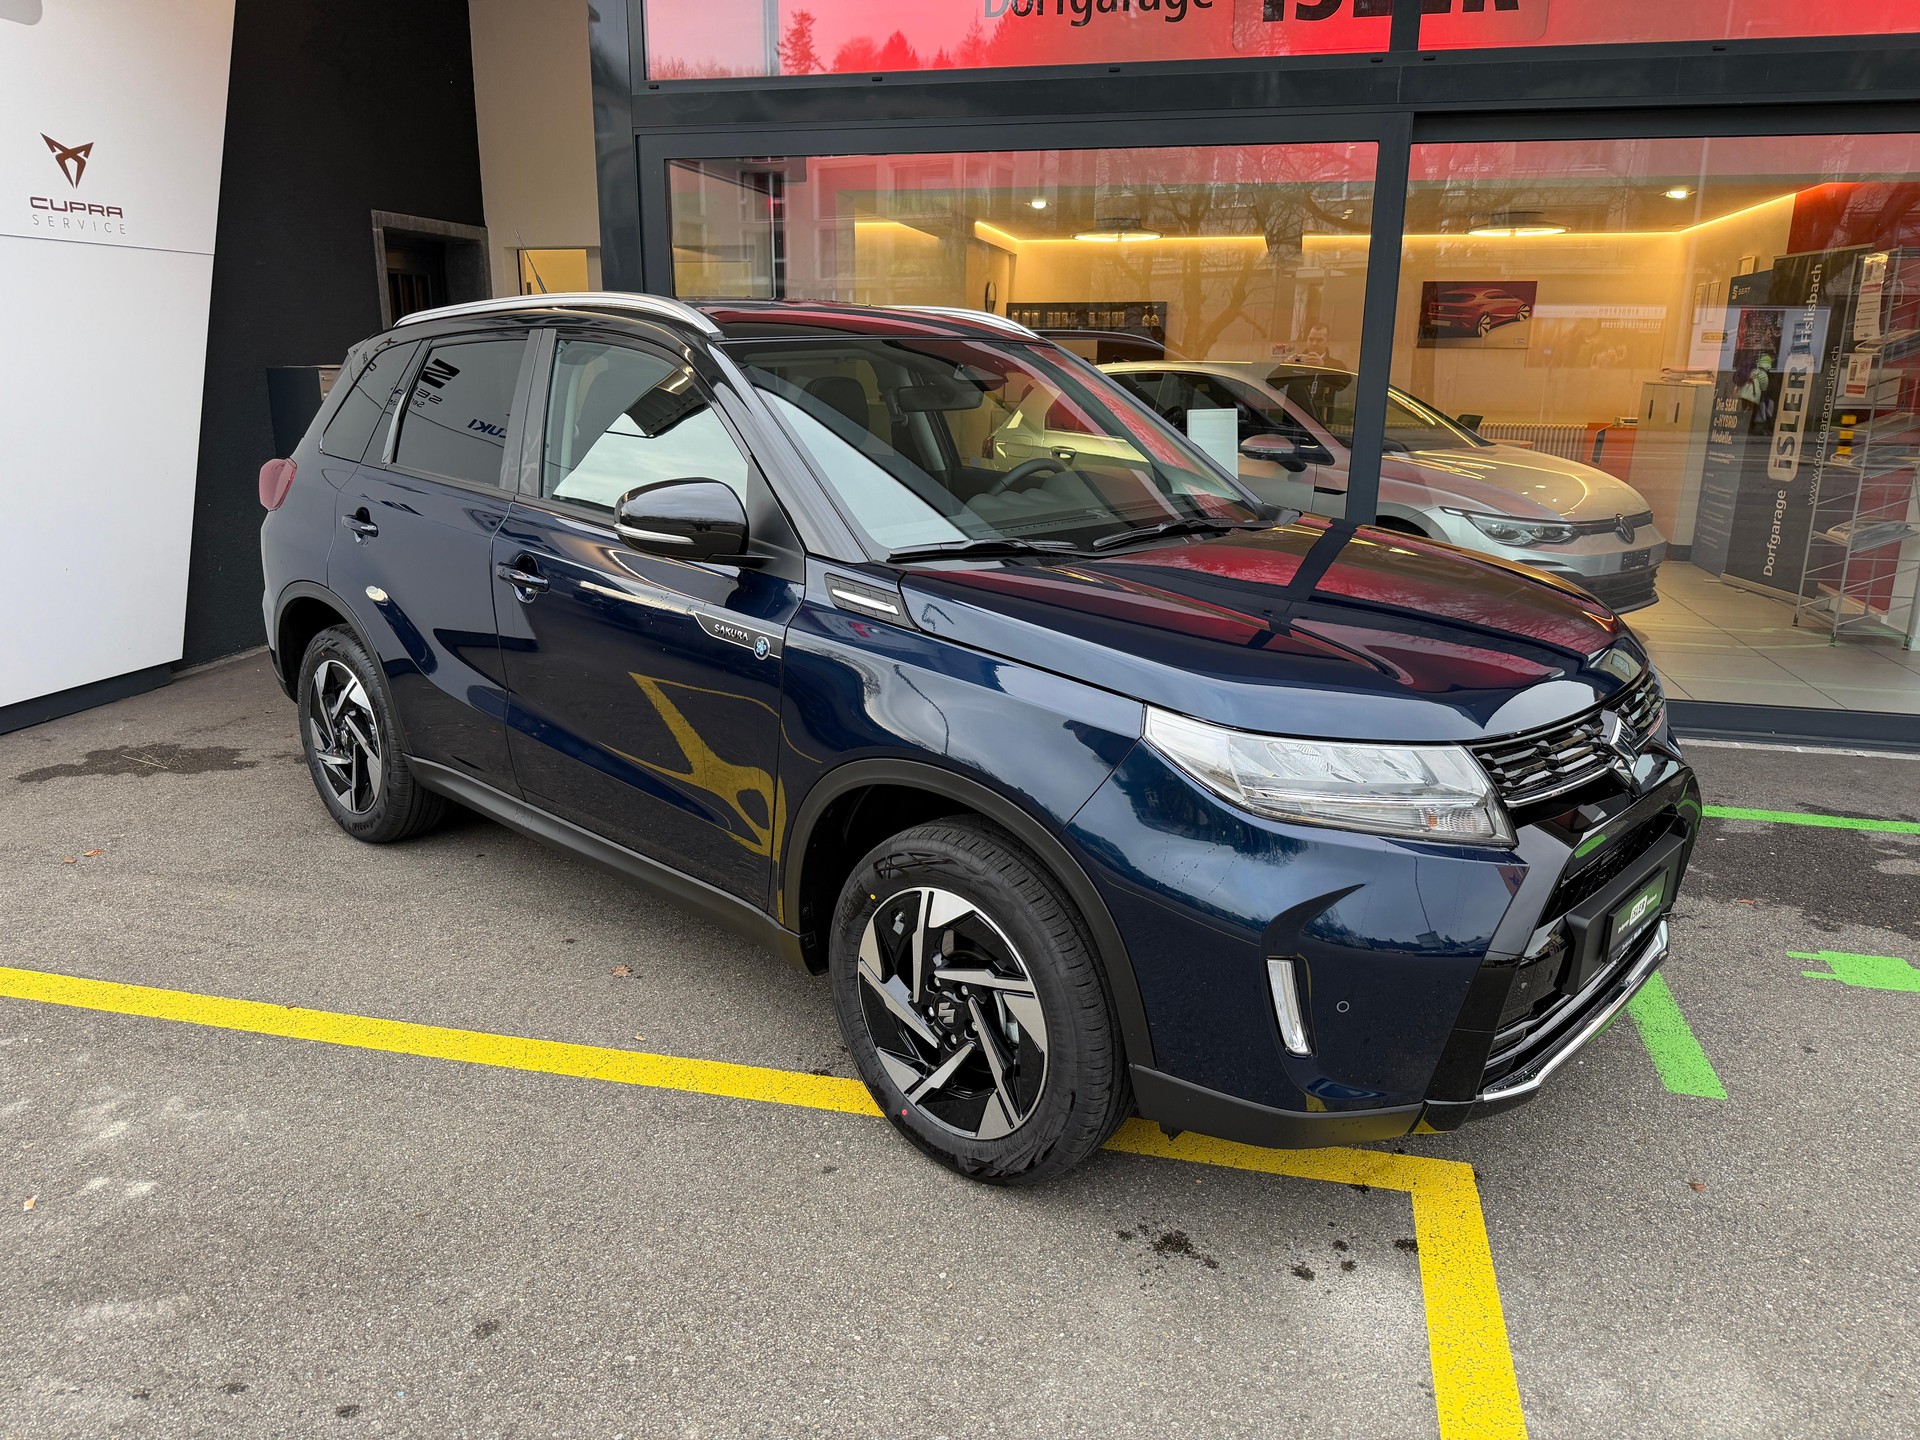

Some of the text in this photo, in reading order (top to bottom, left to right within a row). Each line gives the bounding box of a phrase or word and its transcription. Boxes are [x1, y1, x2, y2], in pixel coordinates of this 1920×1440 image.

[30, 196, 124, 219] CUPRA
[32, 214, 126, 235] SERVICE
[1715, 398, 1739, 412] Die SEAT
[1713, 414, 1738, 429] e-HYBRID
[1763, 489, 1787, 576] Dorfgarage
[714, 623, 749, 642] SAKURA
